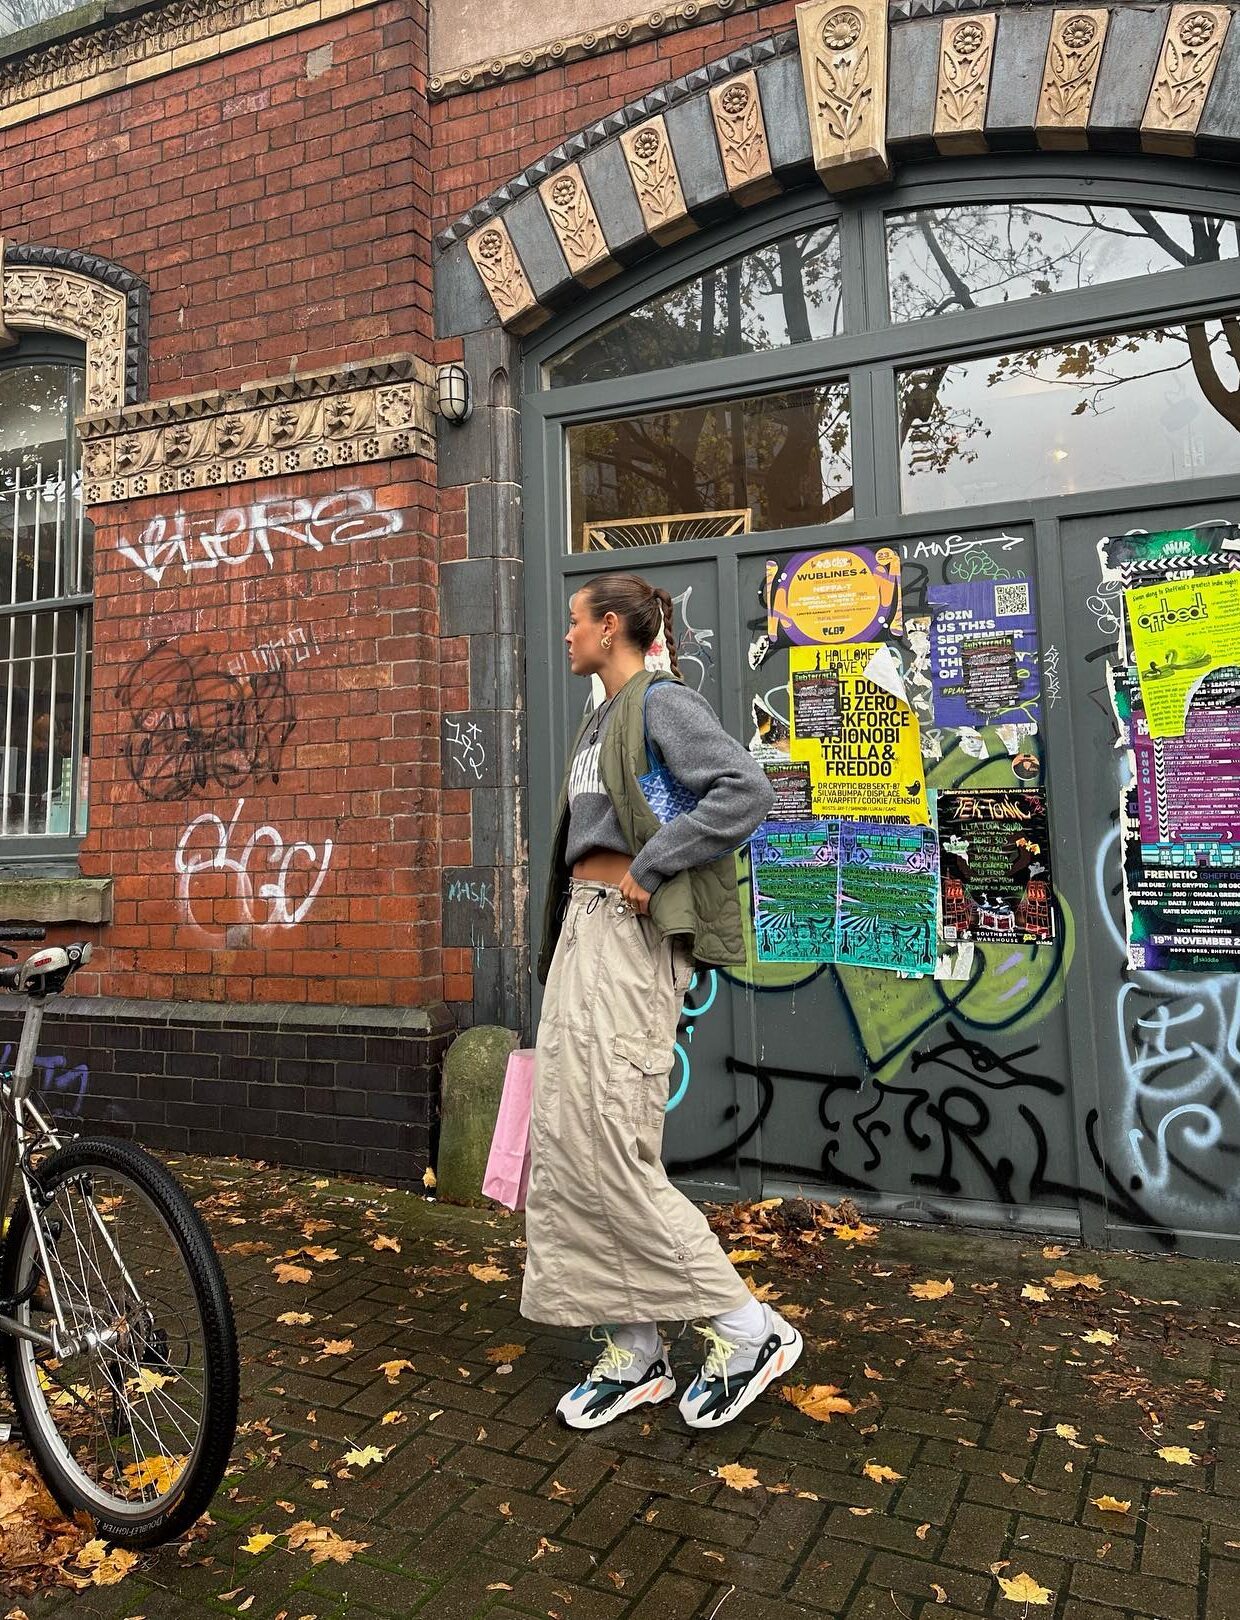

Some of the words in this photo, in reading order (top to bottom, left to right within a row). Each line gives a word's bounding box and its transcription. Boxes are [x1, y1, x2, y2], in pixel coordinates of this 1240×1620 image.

[797, 568, 858, 581] WUBLINES
[859, 567, 867, 575] 4
[936, 609, 973, 622] JOIN
[1138, 592, 1208, 633] offbeat
[936, 622, 956, 634] US
[958, 619, 996, 631] THIS
[937, 629, 1024, 645] SEPTEMBER
[825, 648, 879, 662] HALLOWE
[937, 645, 958, 656] TO
[938, 669, 959, 679] OF
[842, 697, 851, 711] B
[854, 695, 898, 711] ZERO
[840, 711, 910, 727] RKFORCE
[821, 745, 880, 760] TRILLA
[882, 744, 896, 760] &
[826, 760, 892, 776] FREDDO
[1141, 751, 1151, 785] 2022
[893, 797, 921, 805] KENSHO
[1143, 788, 1153, 821] JULY
[859, 815, 882, 823] DRYAD
[883, 815, 910, 824] WORKS
[1144, 870, 1198, 880] FRENETIC
[1153, 935, 1172, 944] 19TH
[1173, 936, 1233, 946] NOVEMBER
[1233, 937, 1240, 945] 2
[102, 1515, 164, 1537] DOUBLEFIGHTER
